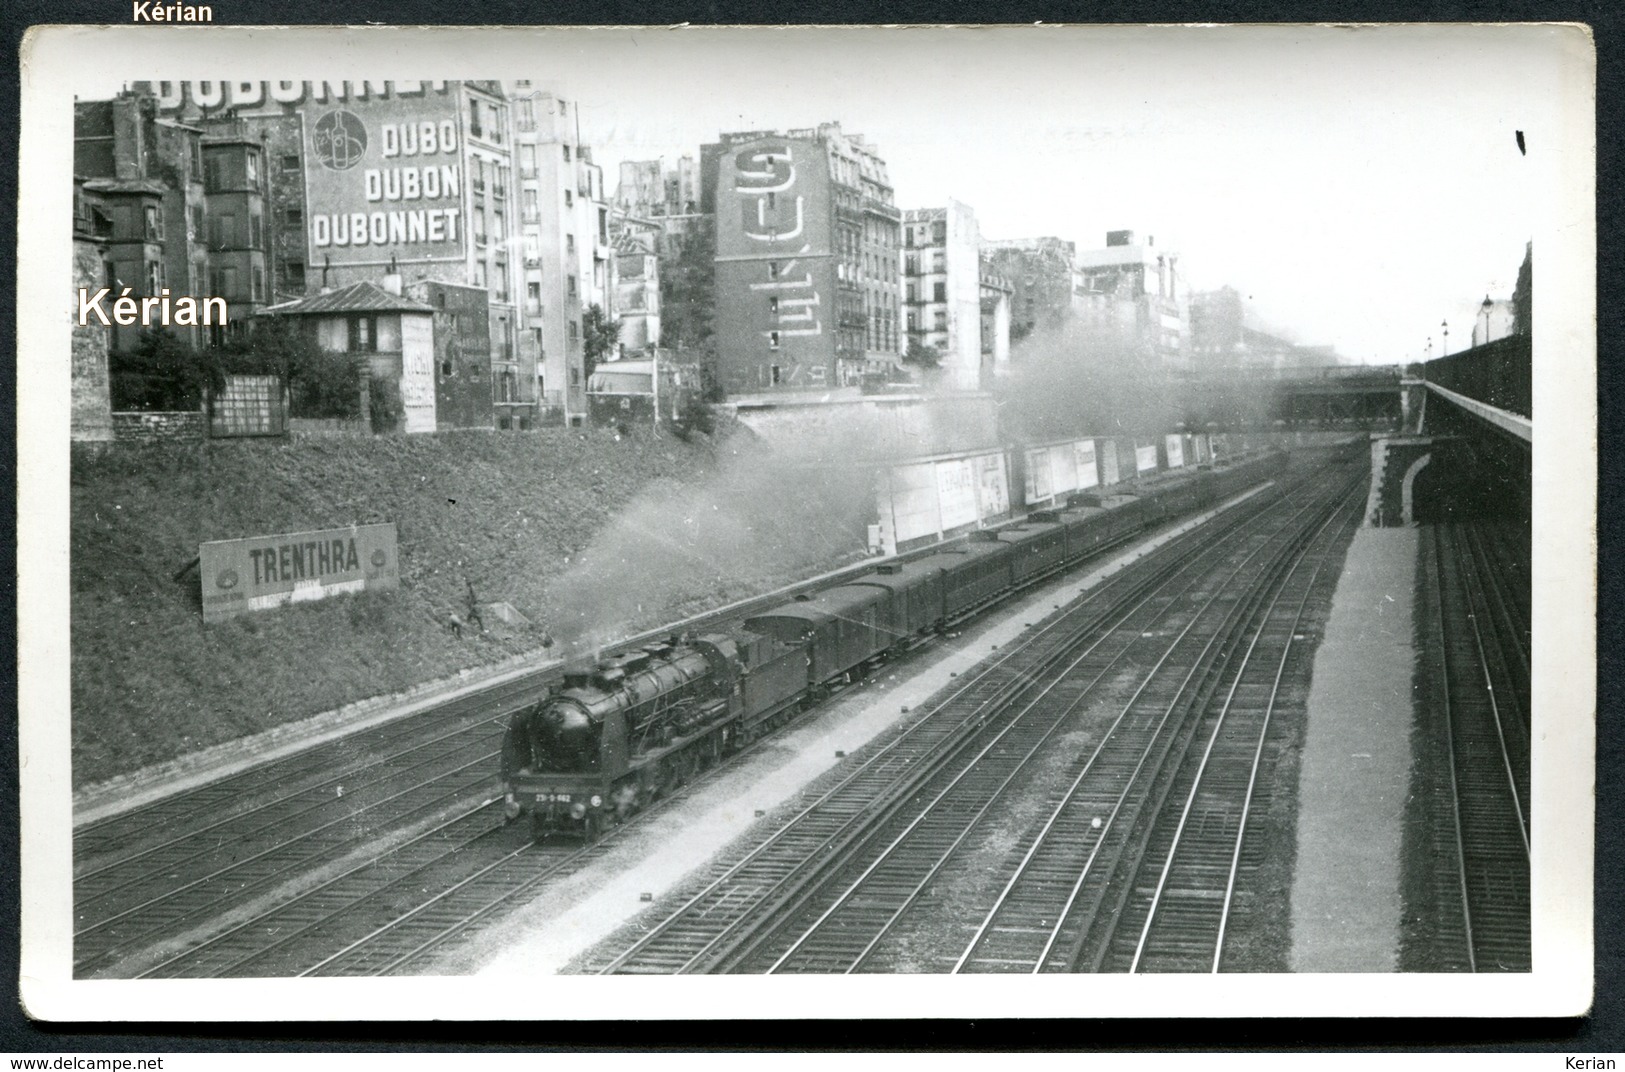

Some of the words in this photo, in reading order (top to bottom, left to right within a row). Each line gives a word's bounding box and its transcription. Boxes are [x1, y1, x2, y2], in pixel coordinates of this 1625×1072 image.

[151, 80, 446, 110] DUBO
[382, 119, 457, 158] DUBO
[364, 166, 460, 202] DUBON
[313, 208, 460, 247] DUBONNET
[249, 536, 360, 585] TRENTHRA
